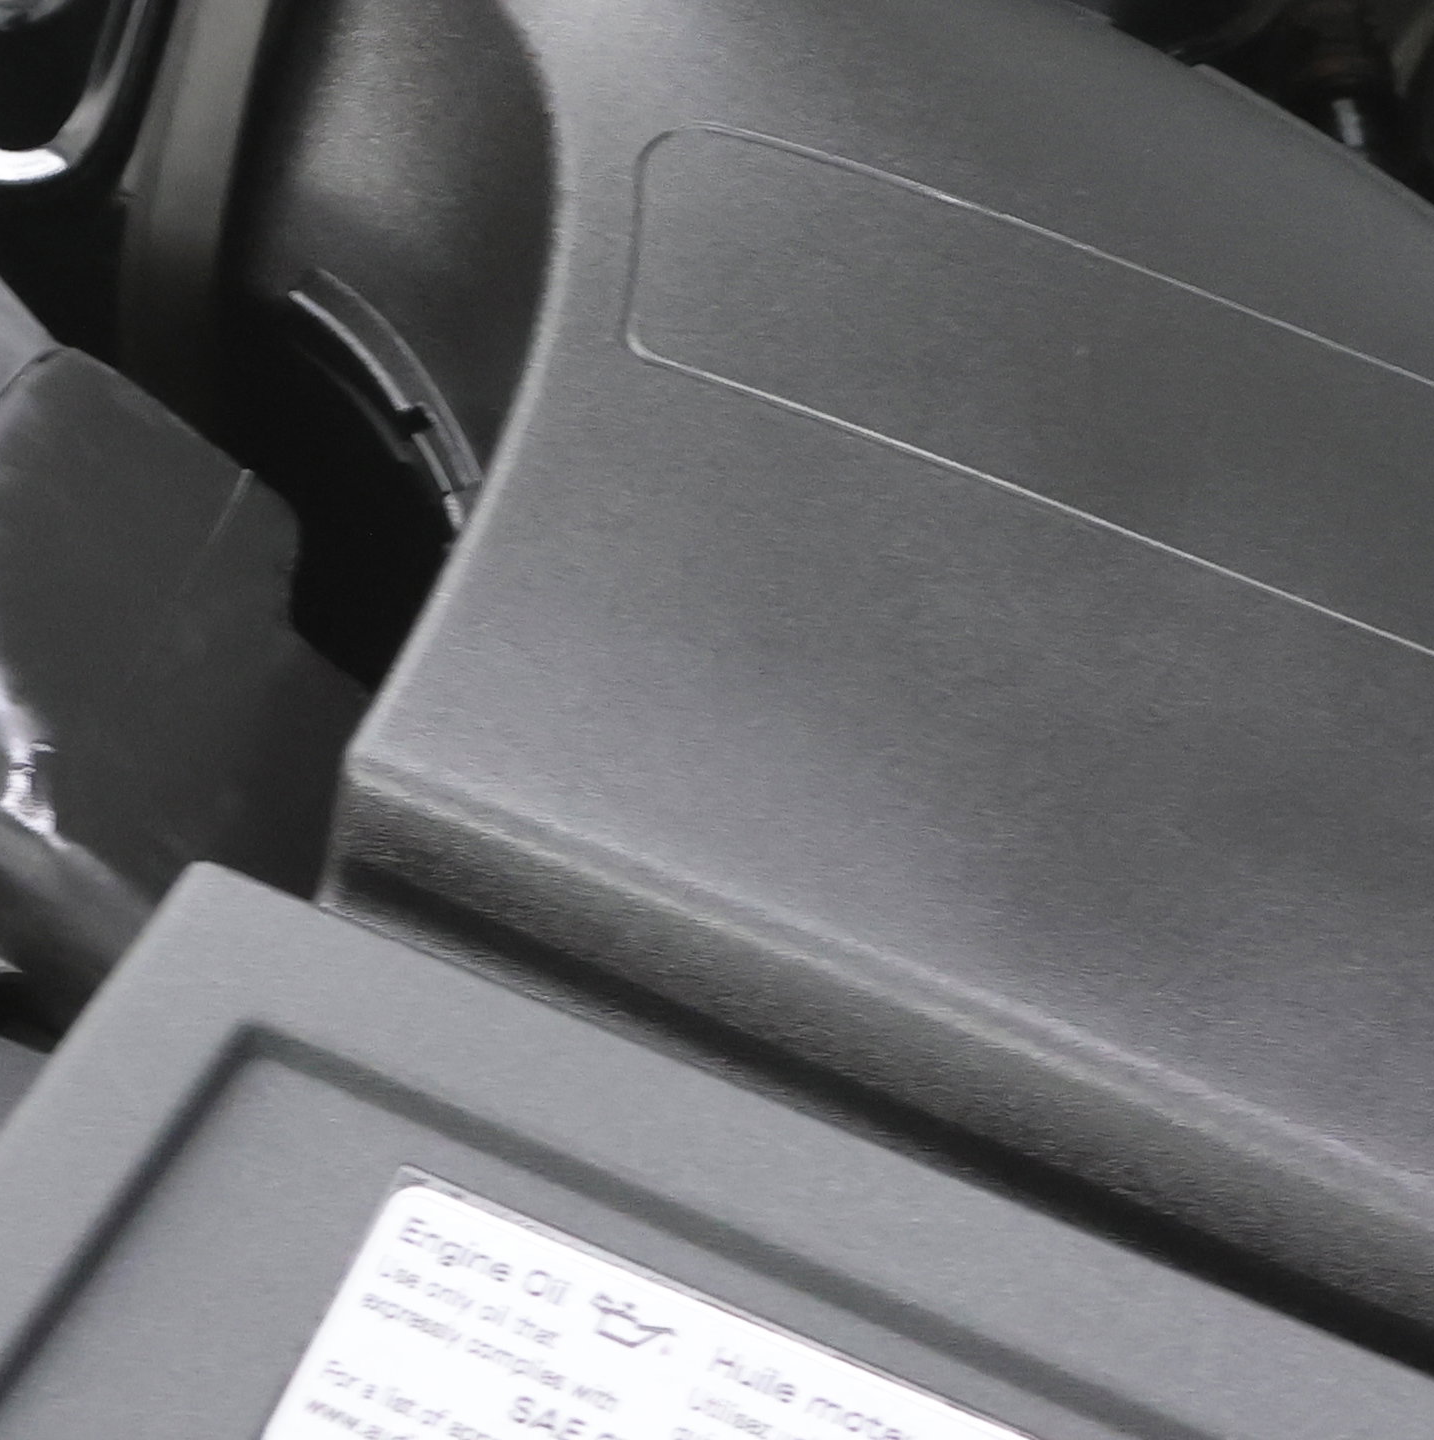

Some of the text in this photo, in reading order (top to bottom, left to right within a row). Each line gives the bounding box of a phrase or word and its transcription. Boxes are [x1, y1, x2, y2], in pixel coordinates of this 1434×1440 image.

[398, 1216, 571, 1306] Engine Oil
[377, 1257, 561, 1350] Use only oil that
[321, 1359, 363, 1388] For
[362, 1291, 464, 1349] expressly
[467, 1337, 566, 1392] complies
[708, 1346, 797, 1404] Huile
[508, 1395, 587, 1440] SAE
